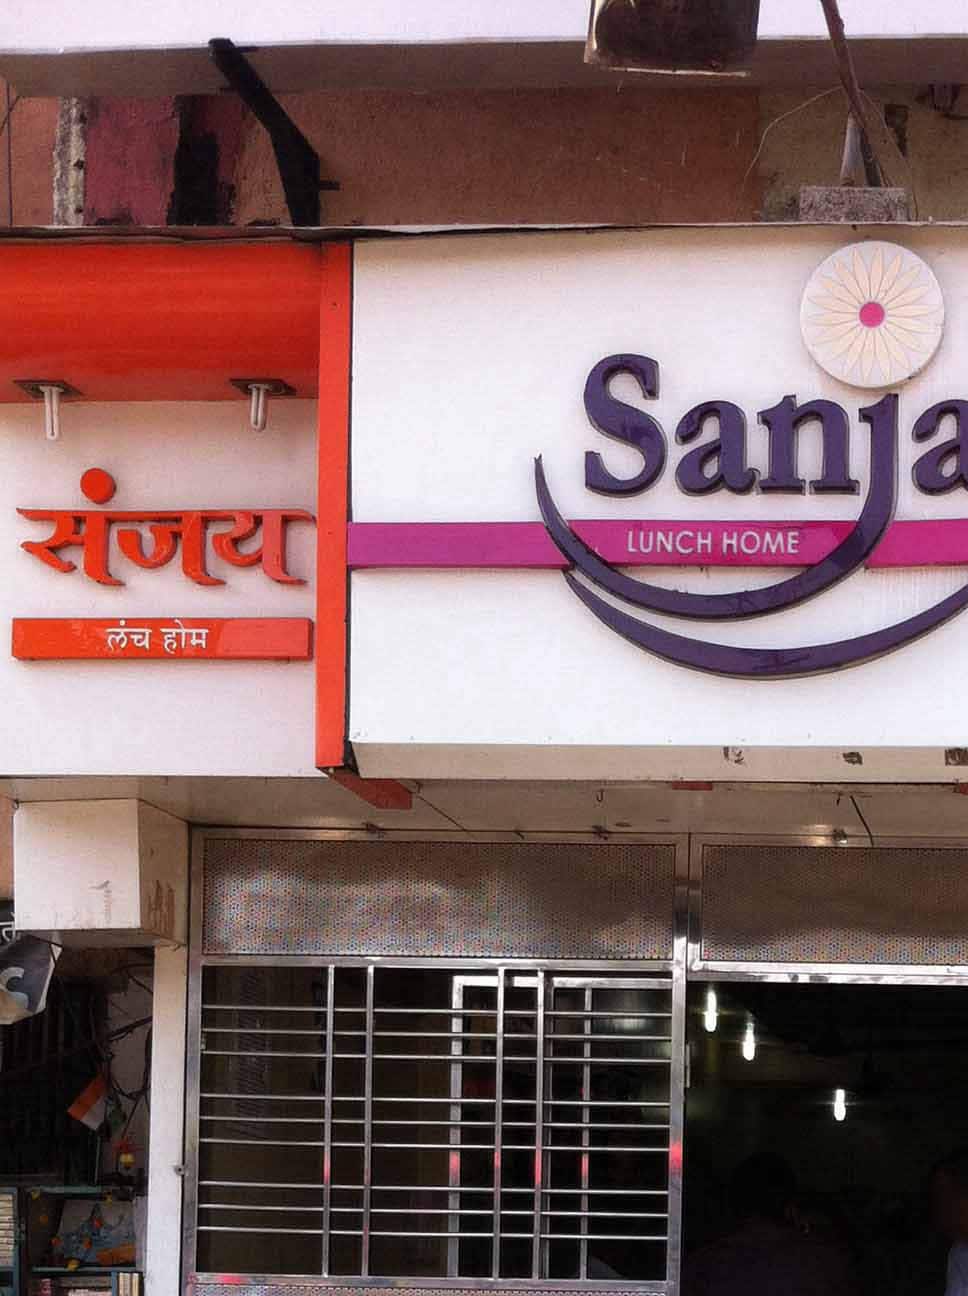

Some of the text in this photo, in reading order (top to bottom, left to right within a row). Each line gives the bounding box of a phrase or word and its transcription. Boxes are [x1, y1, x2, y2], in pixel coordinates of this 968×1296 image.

[16, 467, 317, 587] संजय
[627, 531, 800, 555] LUNCH HOME
[105, 618, 210, 654] लंच होम
